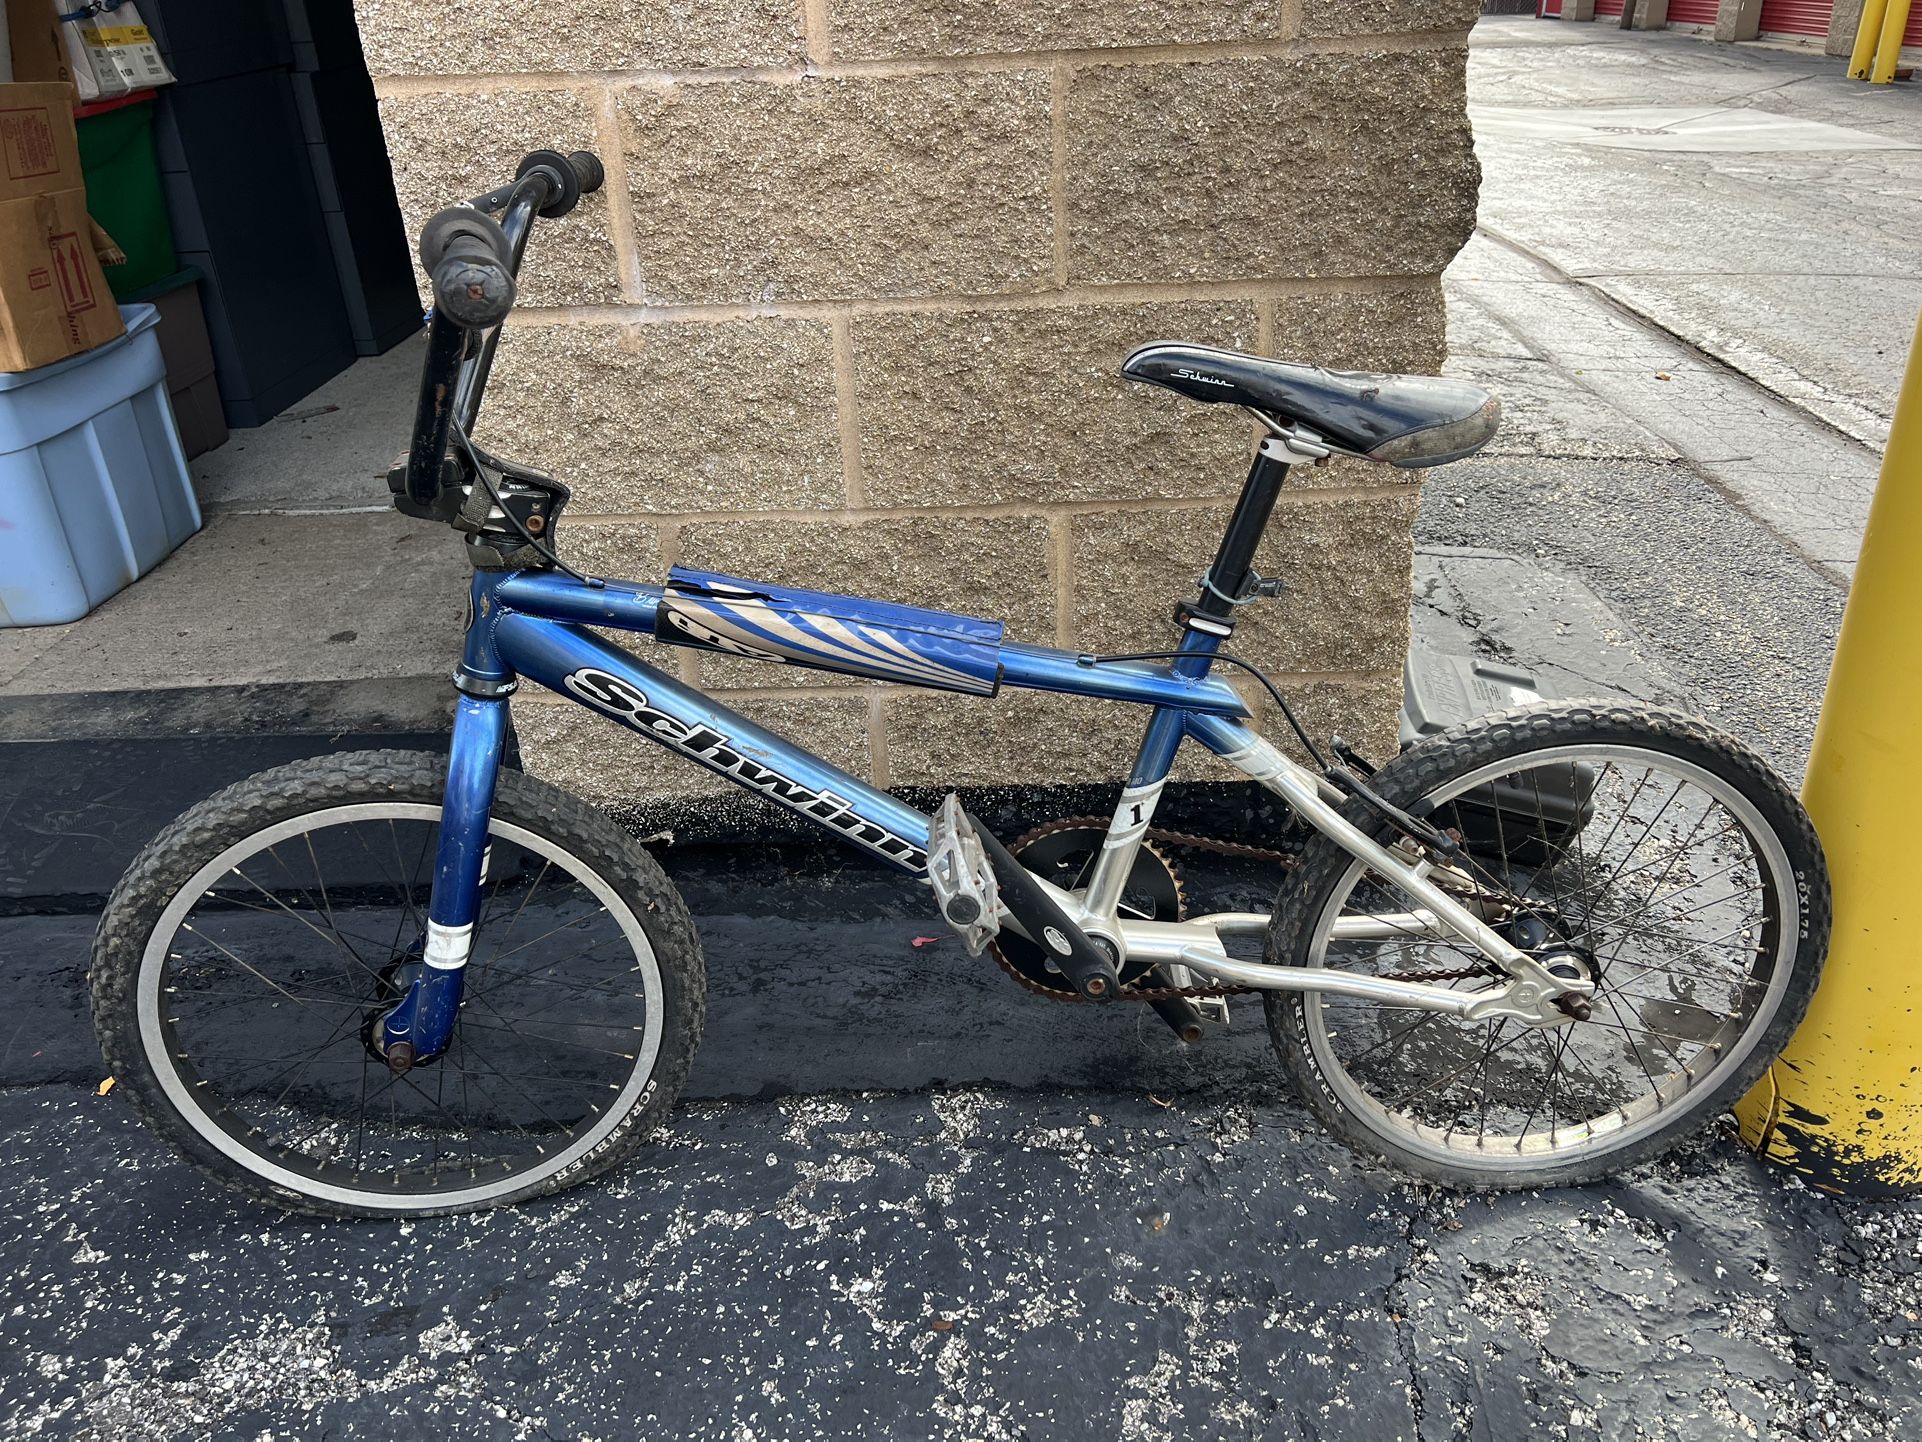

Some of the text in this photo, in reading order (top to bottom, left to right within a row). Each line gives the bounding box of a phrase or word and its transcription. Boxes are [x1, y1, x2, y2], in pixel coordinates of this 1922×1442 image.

[1170, 368, 1235, 387] Schwinn
[564, 668, 928, 874] Schwinn
[1130, 804, 1144, 827] 1
[1294, 1004, 1344, 1114] SCRAMBLER
[554, 1079, 658, 1181] SCRAMBLER
